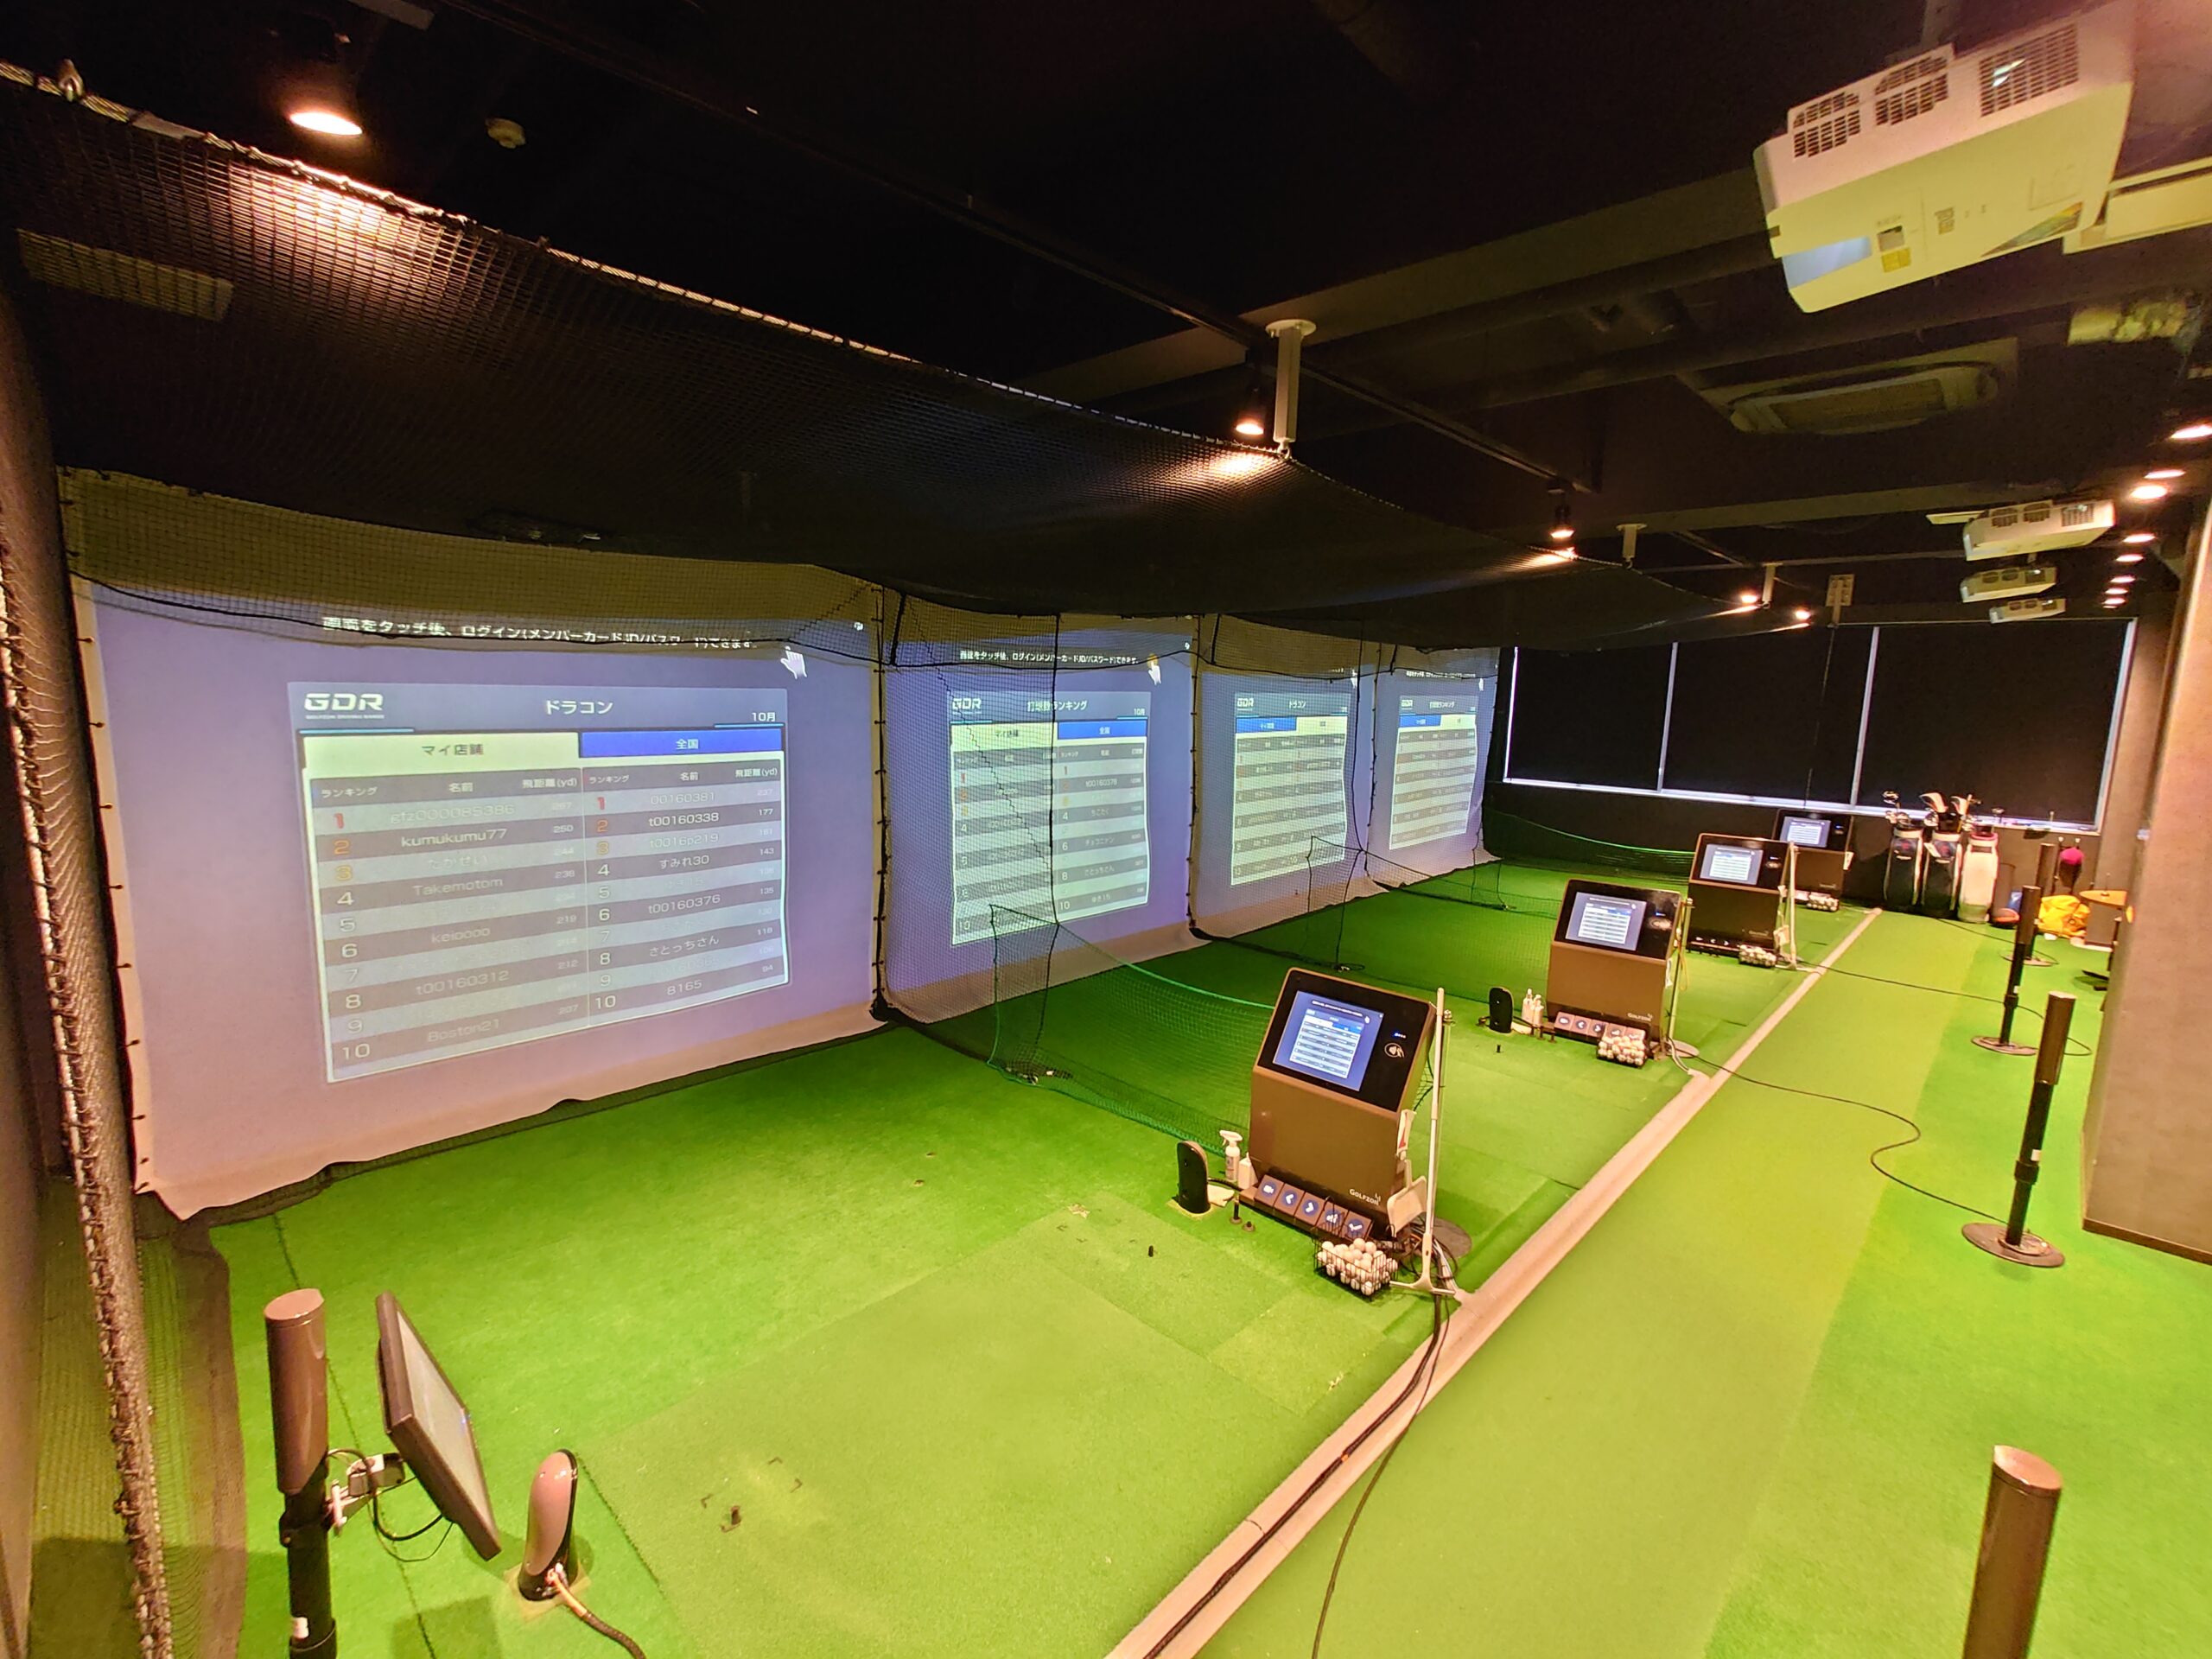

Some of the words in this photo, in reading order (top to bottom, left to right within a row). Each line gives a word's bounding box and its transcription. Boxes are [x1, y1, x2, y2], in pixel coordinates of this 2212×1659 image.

[304, 692, 385, 712] GDR
[546, 700, 613, 715] ドラコン
[751, 711, 777, 722] 10月
[422, 743, 485, 757] マイ店舗
[675, 738, 700, 751] 全国
[589, 773, 630, 785] ランキング
[679, 771, 699, 782] 名前
[321, 785, 378, 799] ランキング
[448, 781, 475, 794] 名前
[596, 797, 606, 810] 1
[334, 812, 345, 830] 1
[596, 819, 609, 834] 2
[648, 811, 720, 827] t00160338
[758, 808, 774, 817] 177
[1062, 811, 1070, 821] 4
[333, 839, 351, 855] 2
[401, 827, 508, 849] kumukumu77
[553, 823, 575, 835] 250
[1062, 842, 1069, 852] 6
[597, 863, 611, 877] 4
[658, 855, 710, 870] すみれ30
[1061, 871, 1069, 880] 8
[337, 891, 356, 906] 4
[598, 886, 611, 899] 5
[598, 907, 612, 922] 6
[648, 893, 721, 914] t00160376
[1059, 900, 1071, 910] 10
[339, 918, 357, 933] 5
[600, 930, 612, 943] 7
[340, 943, 359, 959] 6
[599, 951, 612, 966] 8
[648, 935, 721, 958] さとっちさん
[344, 969, 359, 983] 7
[600, 974, 613, 988] 9
[345, 994, 362, 1010] 8
[415, 969, 511, 995] t00160312
[594, 995, 617, 1010] 10
[667, 981, 703, 996] 8165
[347, 1020, 364, 1034] 9
[341, 1043, 372, 1059] 10
